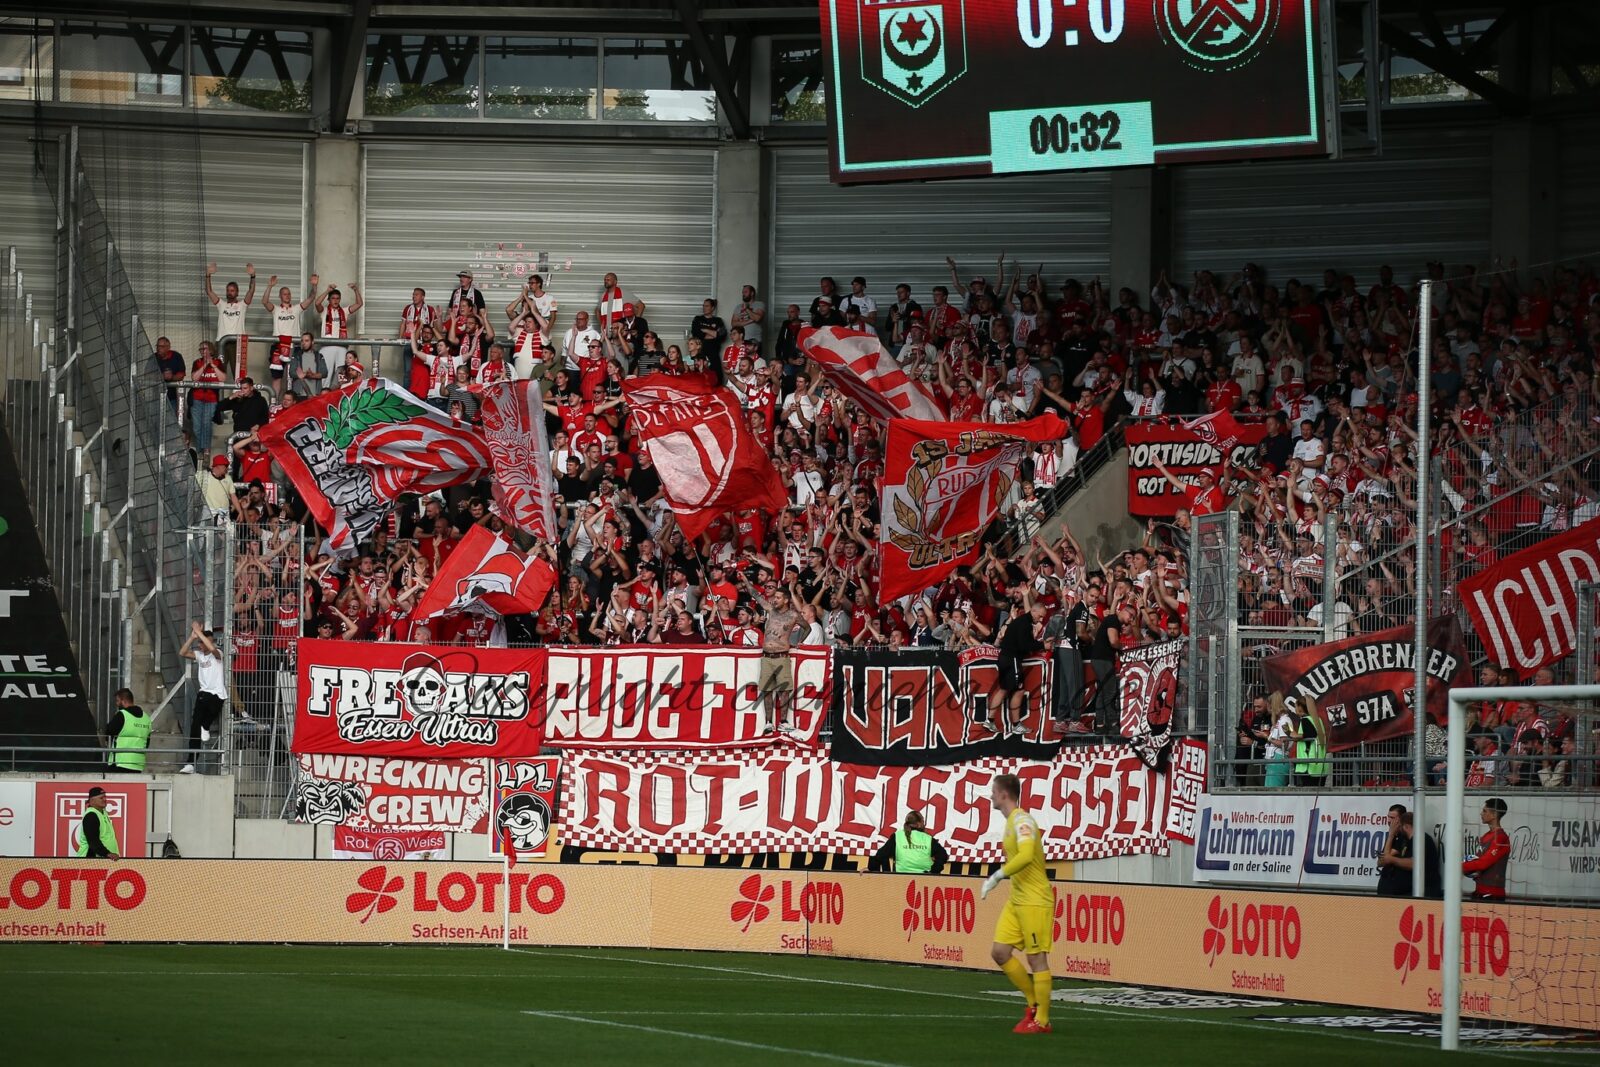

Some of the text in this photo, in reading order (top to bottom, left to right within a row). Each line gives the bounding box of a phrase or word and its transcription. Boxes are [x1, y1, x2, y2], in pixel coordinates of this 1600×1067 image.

[1029, 109, 1122, 155] 00:32
[1137, 476, 1167, 496] ROT
[308, 664, 531, 720] FREAKS
[1284, 642, 1458, 715] AUERBRENER
[544, 655, 684, 740] RUDE
[1355, 694, 1396, 725] 97A
[338, 706, 499, 747] Essen Ultras
[310, 753, 485, 796] WRECKING
[497, 761, 554, 791] LPL
[63, 799, 119, 816] HC
[368, 795, 466, 825] CREW
[1231, 811, 1295, 824] Wohn-Centrum
[1340, 812, 1392, 826] Wohn-Cen
[344, 835, 444, 849] Rot Weiss
[1196, 806, 1296, 871] Lührmann
[1304, 808, 1390, 875] Lührma
[1232, 860, 1292, 873] an der Saline
[1342, 866, 1354, 875] an
[1357, 864, 1374, 876] der
[0, 867, 148, 911] OTTO
[413, 871, 566, 915] LOTTO
[781, 879, 844, 926] LOTTO
[923, 885, 976, 935] LOTTO
[1066, 893, 1126, 946] LOTTO
[0, 921, 107, 938] chsen-Anhalt
[780, 934, 834, 952] Sachsen-Anhalt
[1231, 902, 1302, 960] LOTTO
[1427, 913, 1510, 977] LTTO
[923, 943, 965, 963] Sachsen-Anhalt
[1065, 955, 1112, 977] Sachsen-Anhalt
[1231, 970, 1286, 993] Sachsen-Anhalt
[1427, 987, 1492, 1014] Sac-Anhalt
